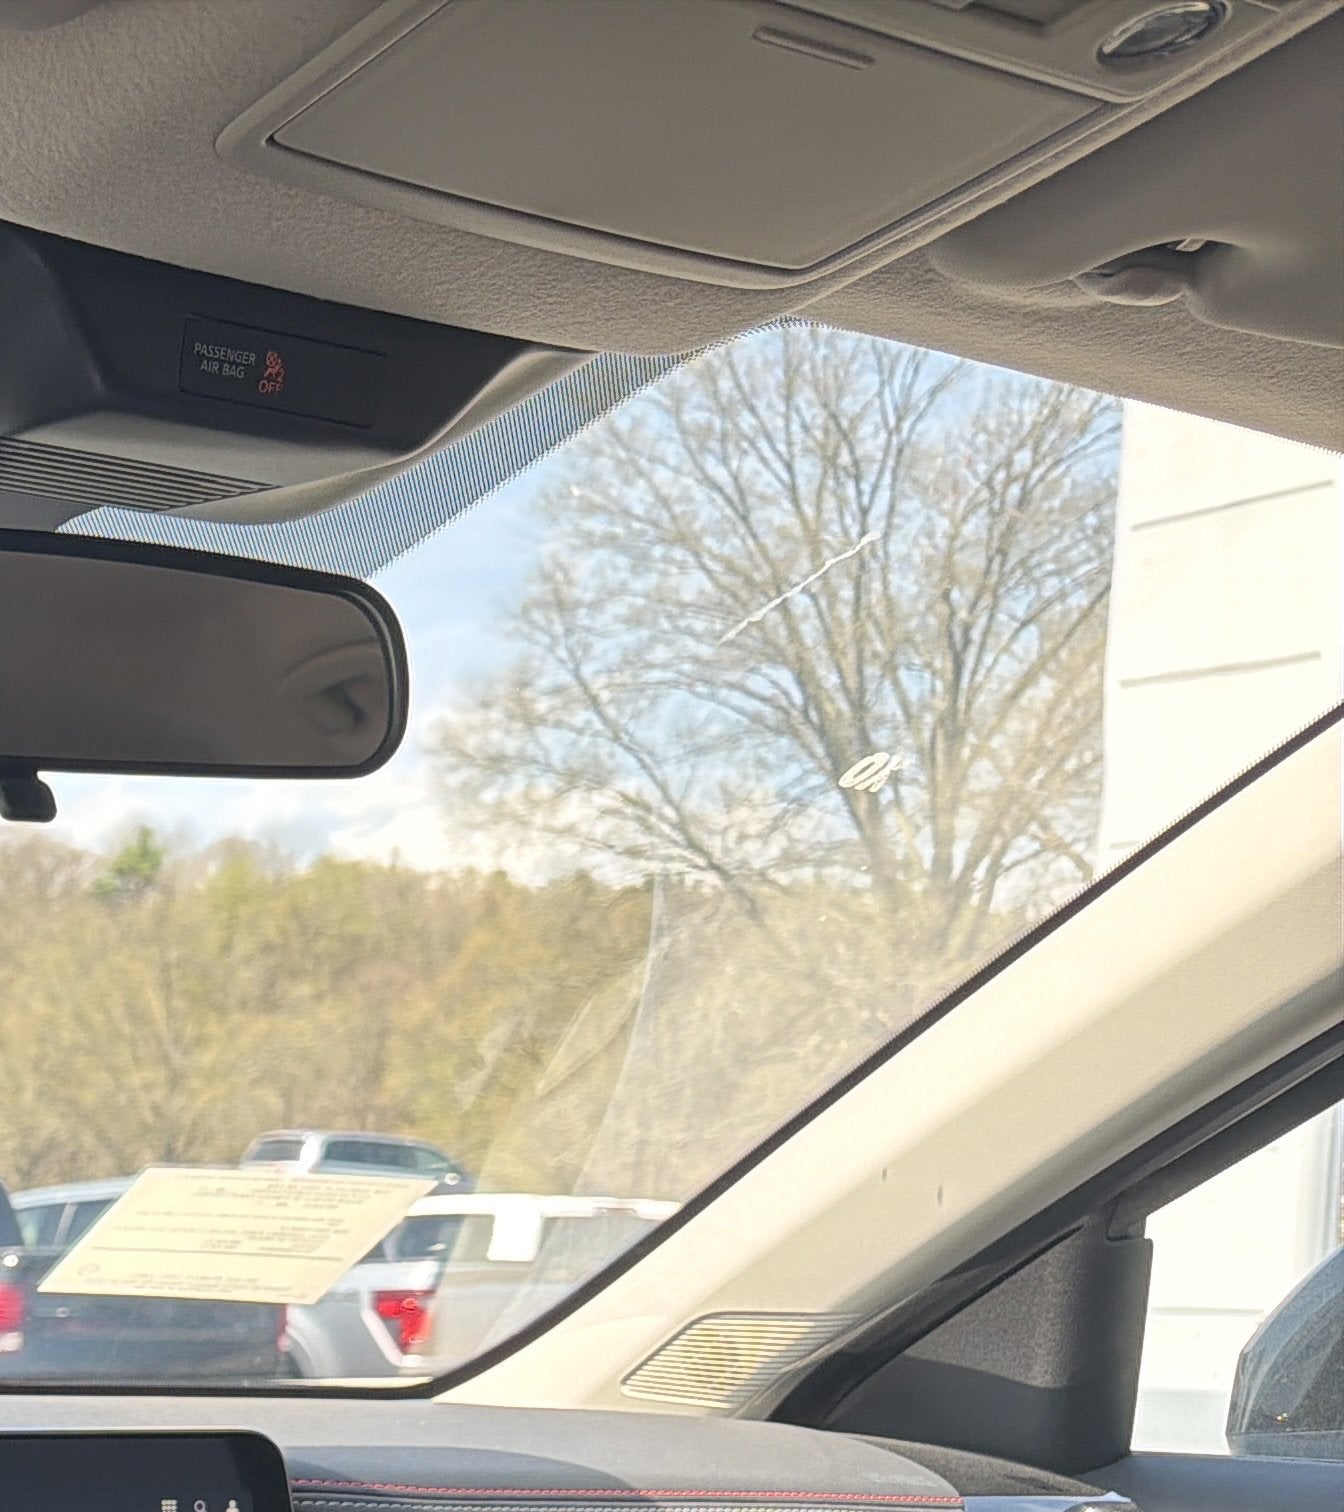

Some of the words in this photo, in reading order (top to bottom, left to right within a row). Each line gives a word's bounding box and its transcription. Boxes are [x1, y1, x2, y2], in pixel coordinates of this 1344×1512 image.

[193, 342, 256, 366] PASSENGER
[200, 359, 219, 374] AIR
[222, 363, 245, 378] BAG
[258, 380, 284, 393] OFF
